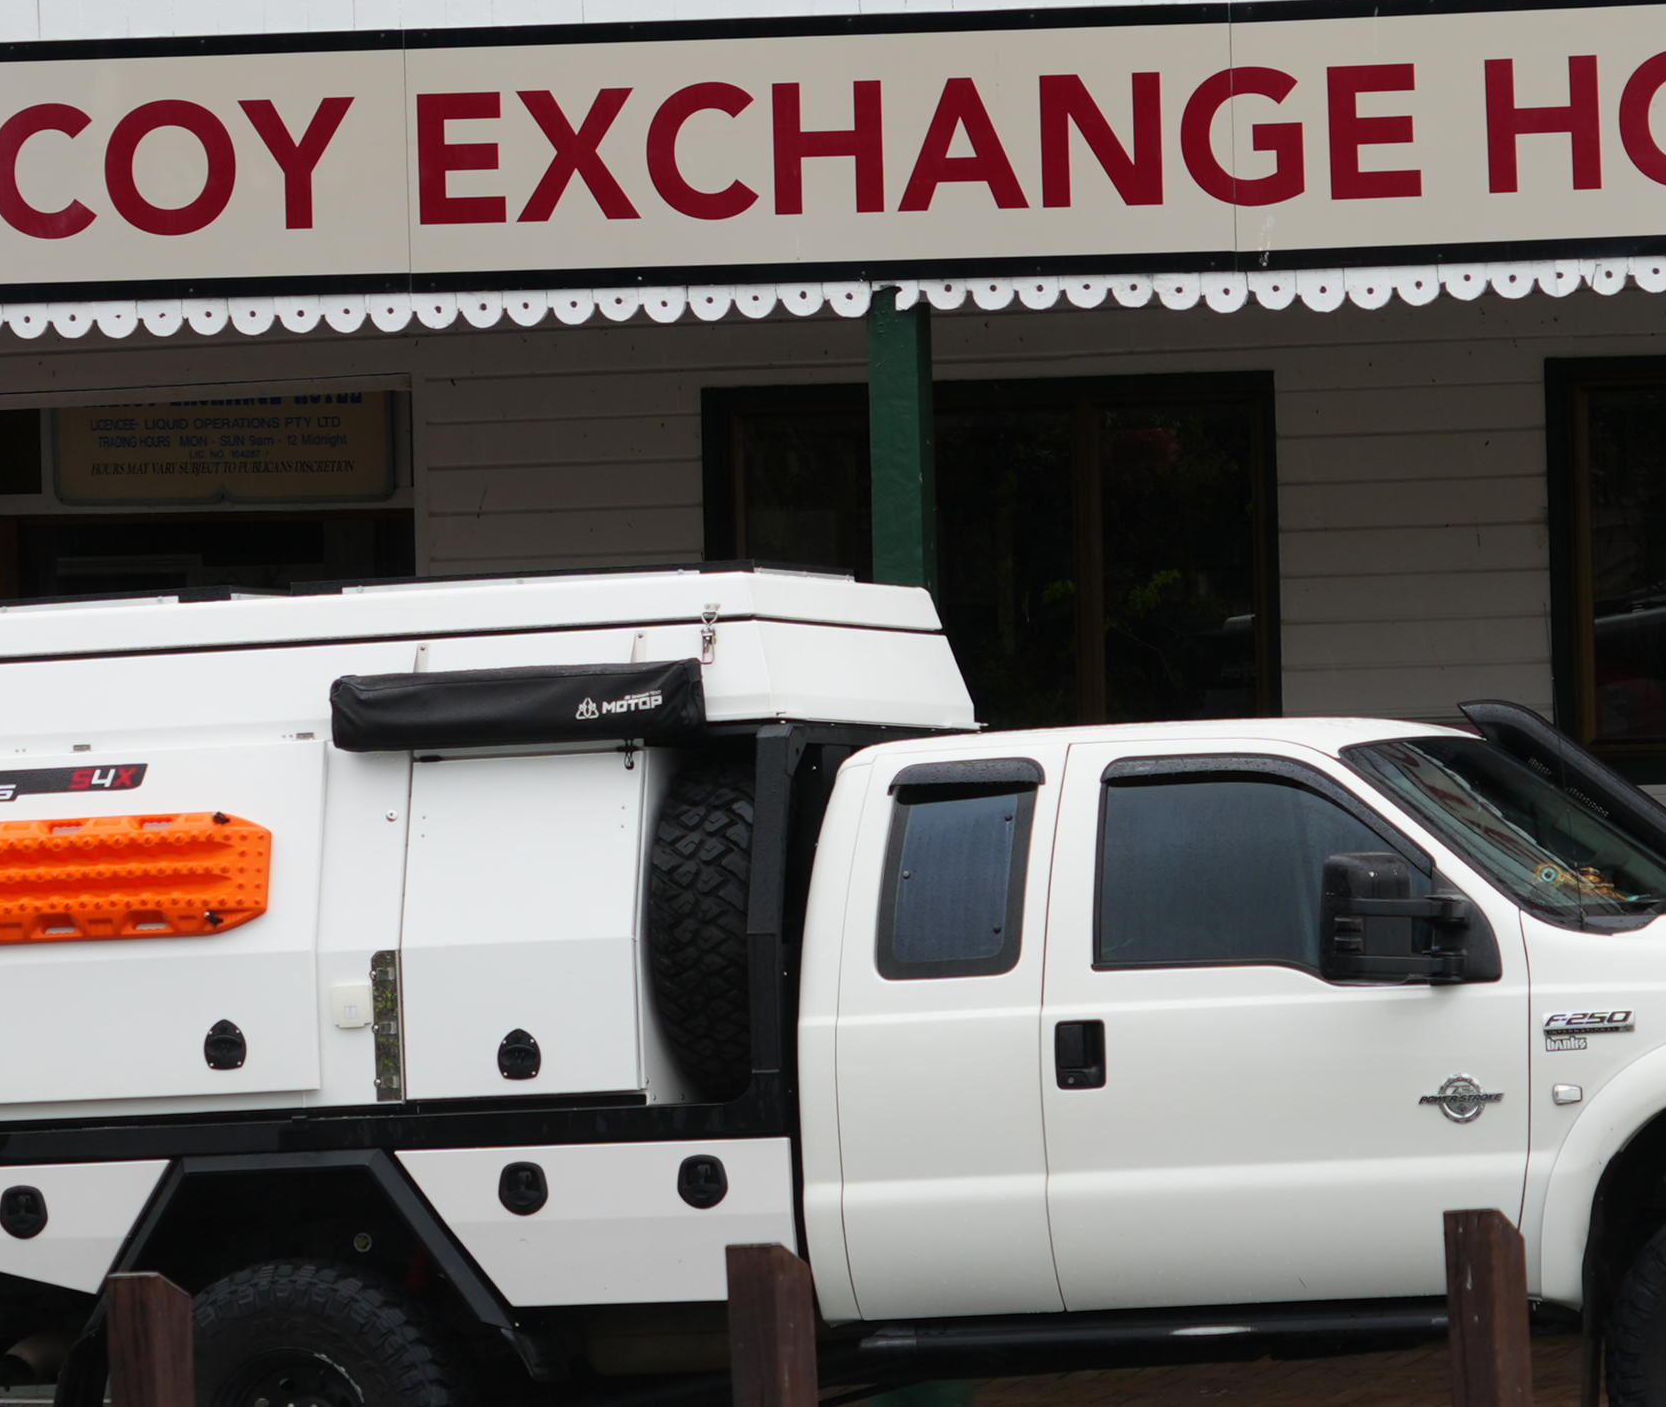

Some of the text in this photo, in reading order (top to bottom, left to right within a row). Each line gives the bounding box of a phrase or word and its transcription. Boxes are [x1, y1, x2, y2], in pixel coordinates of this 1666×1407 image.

[416, 63, 1422, 225] EXCHANGE
[144, 417, 188, 431] LIQUID
[193, 416, 280, 430] OPERATIONS
[285, 416, 311, 428] PTY
[317, 416, 341, 428] LTD
[140, 435, 170, 448] HOURS
[179, 434, 207, 447] MON
[220, 434, 245, 446] SUN
[287, 434, 298, 446] 12
[301, 434, 347, 448] Midnight
[92, 459, 356, 476] HOURS MAY VARY SUBJECT TO PUBLICANS DISCRETION
[602, 695, 663, 714] MOTOP
[69, 768, 137, 791] S4X
[1545, 1010, 1633, 1027] F-250
